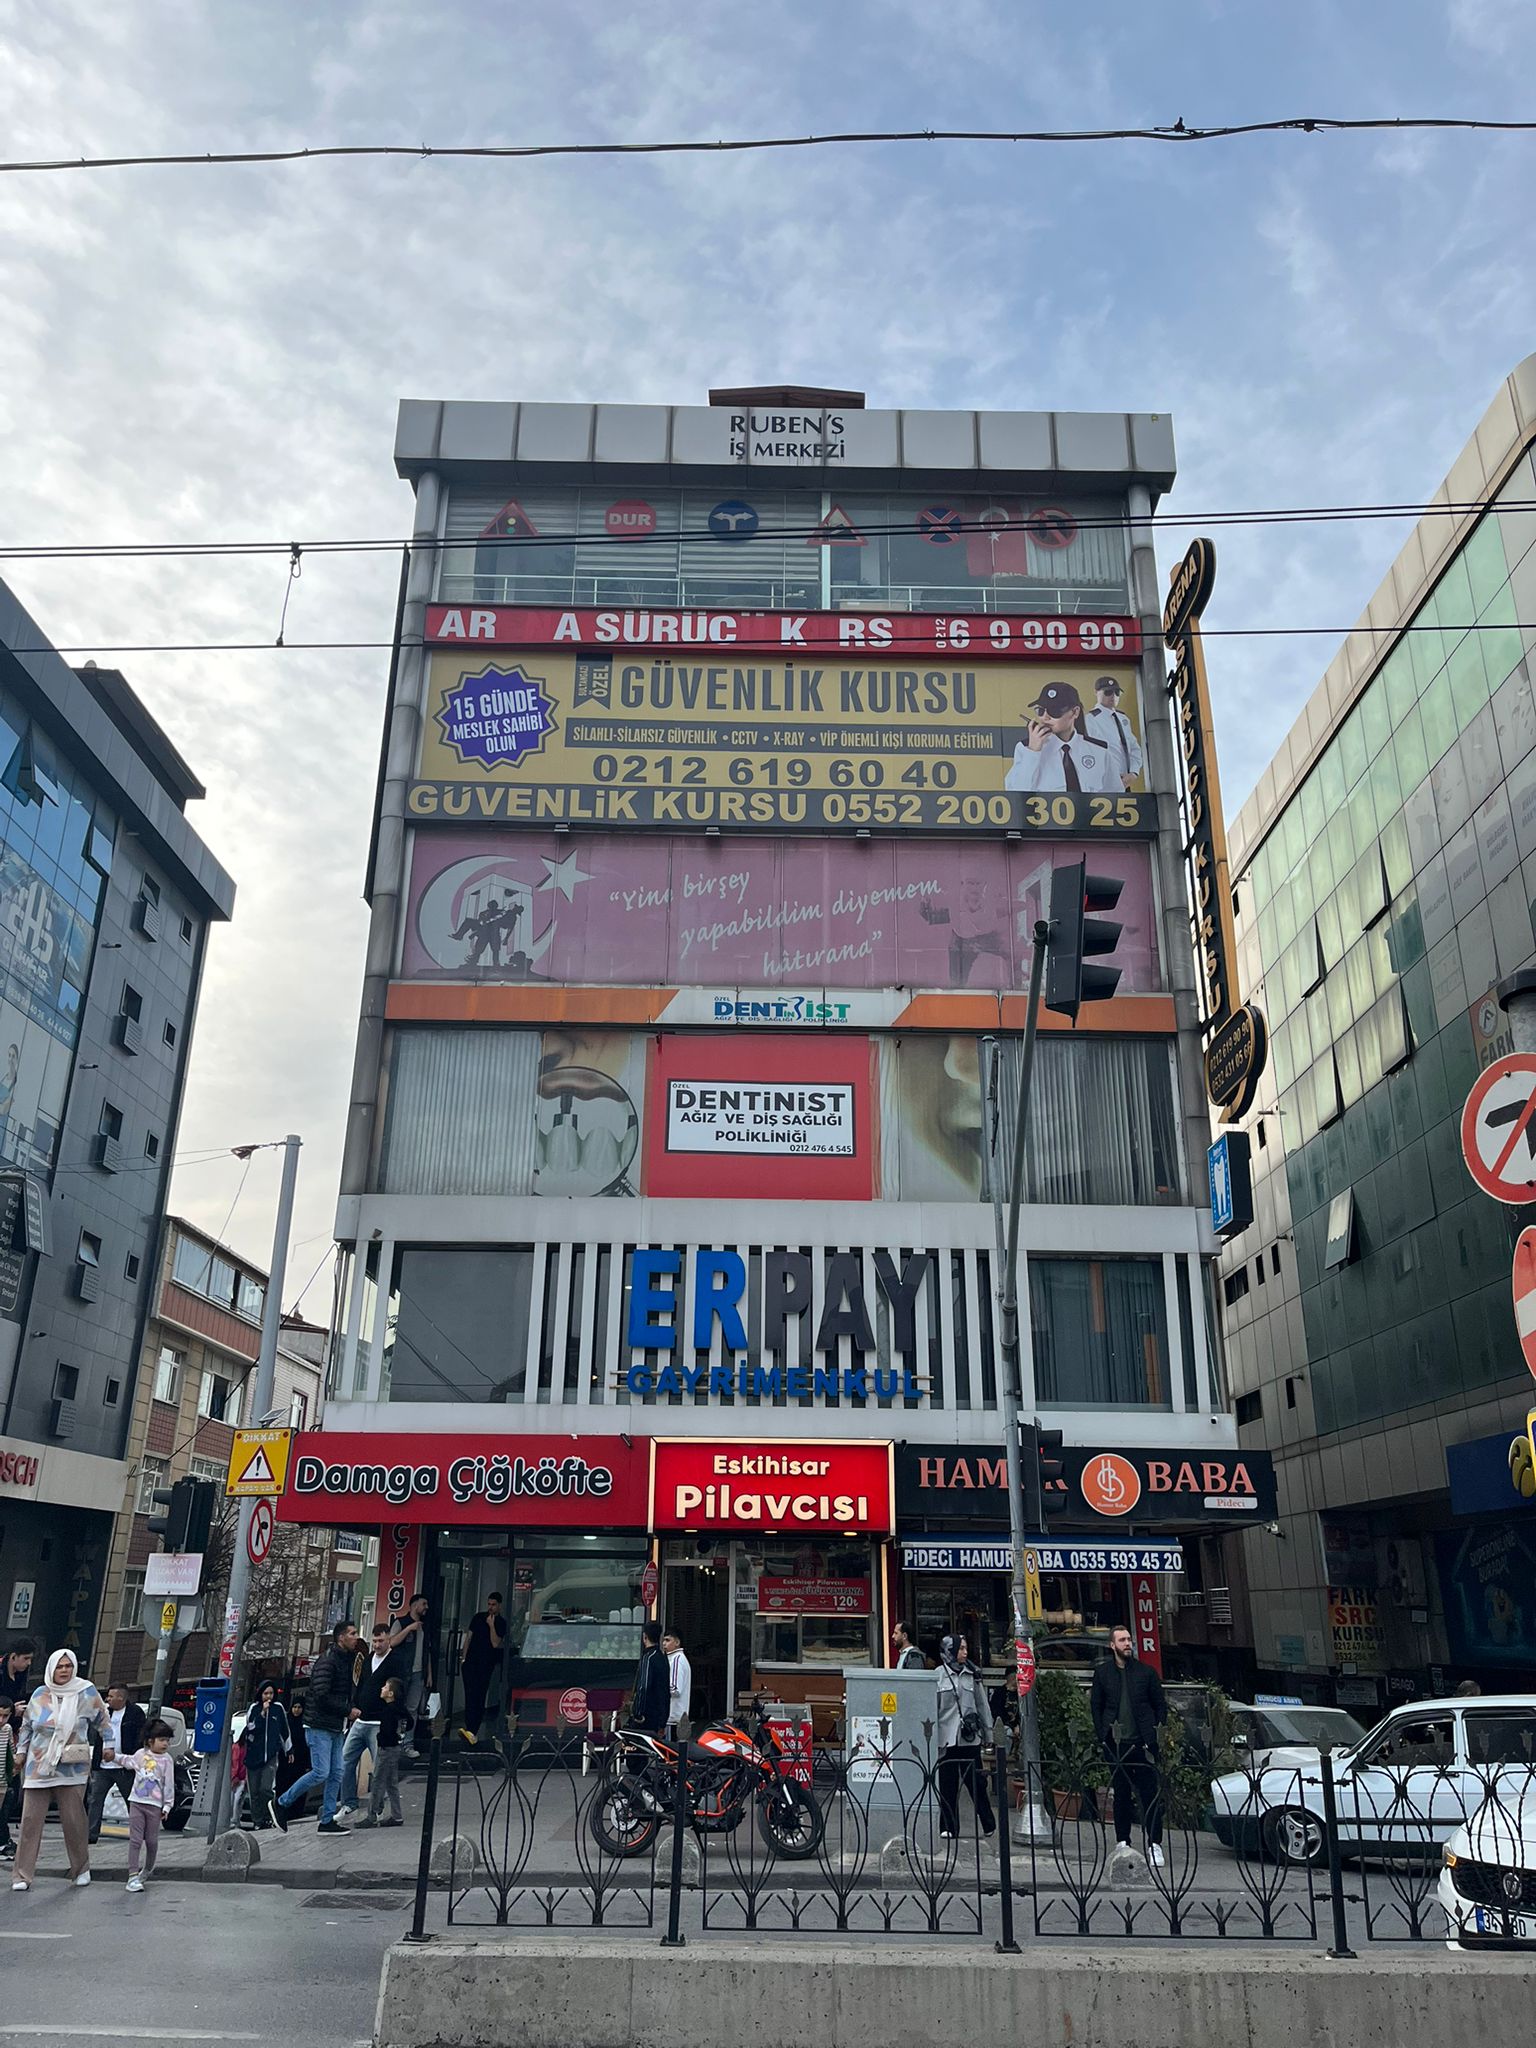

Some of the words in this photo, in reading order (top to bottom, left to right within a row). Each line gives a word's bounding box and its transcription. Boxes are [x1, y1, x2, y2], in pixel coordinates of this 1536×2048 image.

[730, 414, 845, 435] RUBEN'S
[754, 439, 845, 458] MERKEZİ
[608, 512, 651, 526] DUR
[1163, 553, 1198, 634] ARENA
[1022, 621, 1068, 651] 90
[1079, 621, 1125, 651] 90
[588, 665, 609, 698] ÖZEL
[620, 659, 825, 712] GÜVENLİK
[840, 669, 977, 715] KURSU
[453, 696, 475, 721] 15
[476, 688, 539, 718] GÜNDE
[453, 718, 501, 741] MESLEK
[502, 711, 544, 734] SAHİBİ
[667, 727, 717, 745] GÜVENLİK
[731, 730, 758, 745] CCTV
[773, 731, 805, 746] X-RAY
[820, 728, 839, 747] VİP
[840, 728, 880, 748] ÖNEMLİ
[882, 730, 904, 750] KİŞİ
[906, 732, 951, 748] KORUMA
[953, 731, 994, 750] EĞİTİMİ
[485, 734, 517, 754] OLUN
[592, 754, 707, 784] 0212
[728, 757, 812, 787] 619
[829, 759, 885, 788] 60
[901, 760, 957, 789] 40
[653, 790, 807, 823] KURSU
[822, 795, 922, 823] 0552
[936, 797, 1012, 826] 200
[1025, 798, 1075, 827] 30
[1089, 798, 1140, 828] 25
[1174, 639, 1202, 828] SÜRÜCÜ
[1193, 841, 1222, 1017] KURSU
[683, 872, 749, 904] birşey
[680, 901, 824, 959] yapabildim
[832, 879, 942, 925] diyemem
[680, 1109, 717, 1123] AĞIZ
[725, 1113, 745, 1124] VE
[753, 1112, 778, 1127] DİŞ
[782, 1112, 842, 1126] SAĞLIĞI
[715, 1129, 807, 1143] POLİKLİNİĞİ
[789, 1144, 809, 1152] 0212
[811, 1144, 827, 1152] 476
[836, 1145, 852, 1153] 545
[628, 1249, 930, 1352] ERPAY
[626, 1359, 924, 1399] GAYRİMENKUL
[294, 1456, 440, 1504] Damga
[449, 1454, 613, 1504] Çiğköfte
[713, 1455, 830, 1476] Eskihisar
[1146, 1460, 1257, 1494] BABA
[675, 1484, 868, 1521] Pilavcısı
[1216, 1497, 1247, 1508] Pideci
[1070, 1551, 1106, 1569] 0535
[1110, 1552, 1138, 1570] 593
[1141, 1553, 1161, 1570] 45
[1163, 1553, 1183, 1571] 20
[1335, 1607, 1377, 1625] SRC
[1333, 1626, 1384, 1642] KURSU
